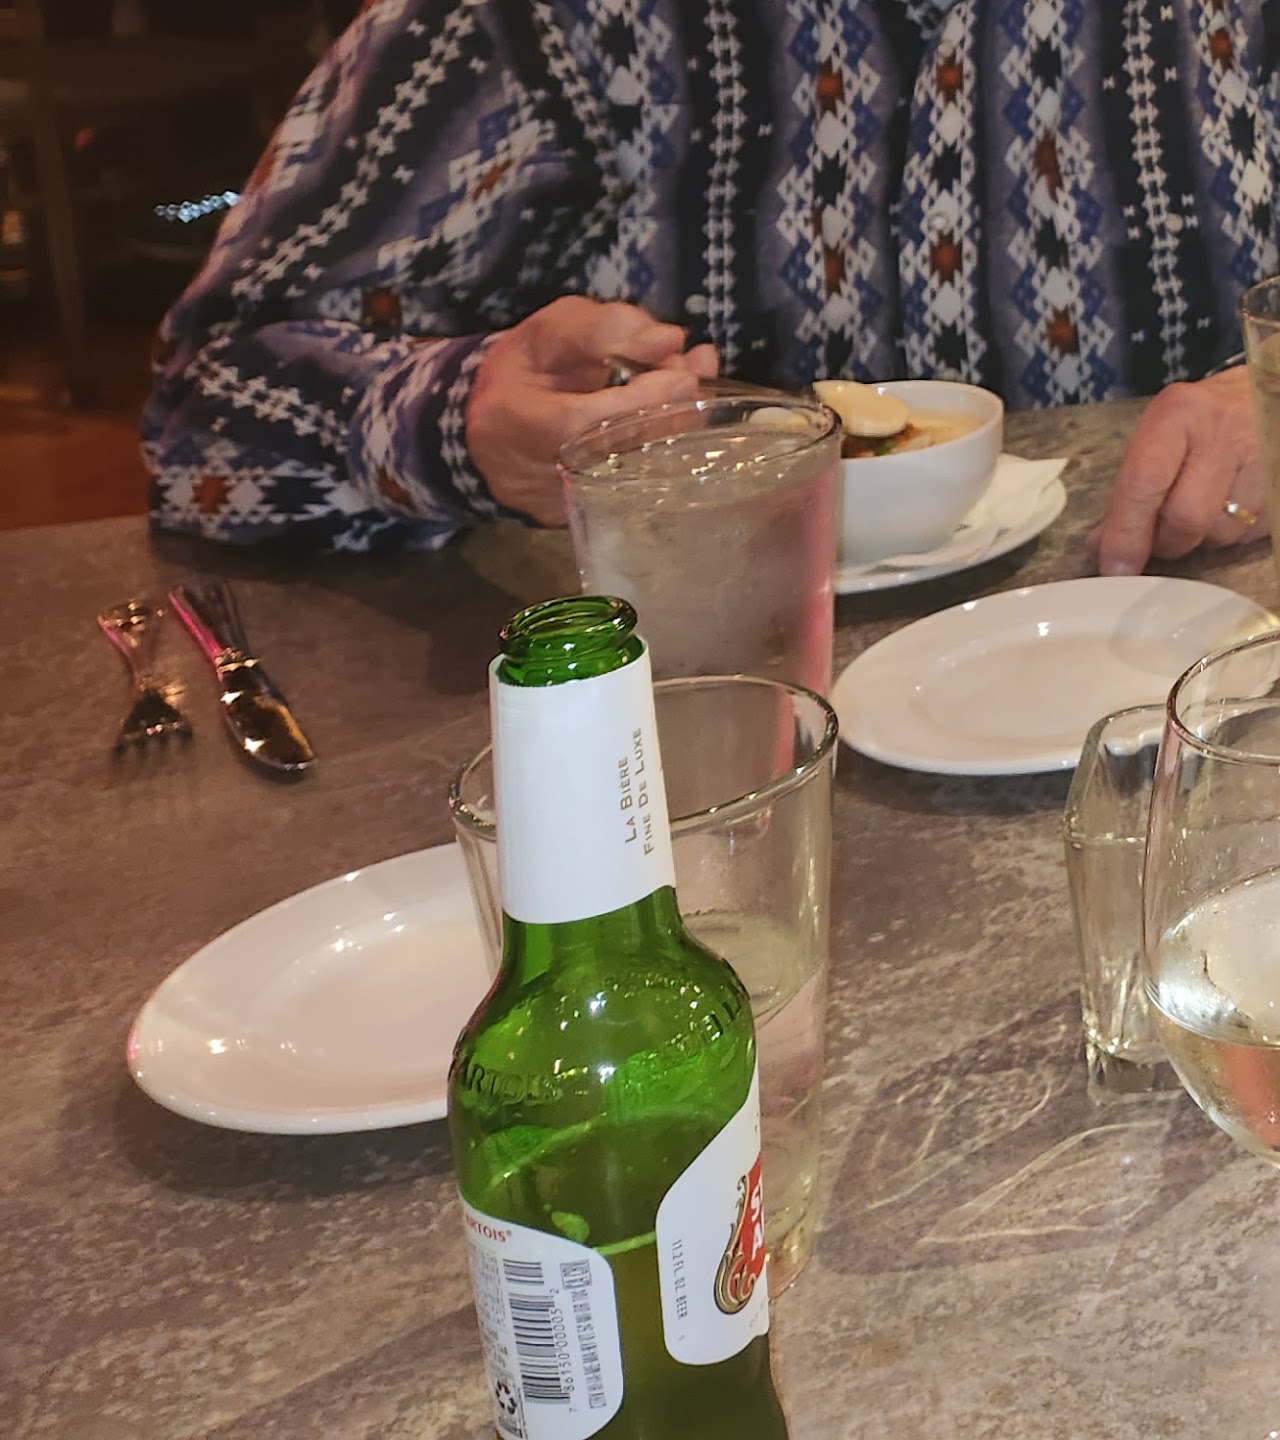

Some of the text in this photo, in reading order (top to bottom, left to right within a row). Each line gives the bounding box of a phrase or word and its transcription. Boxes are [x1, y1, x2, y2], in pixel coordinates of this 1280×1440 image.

[632, 727, 654, 857] FINE DE LUXE
[625, 816, 637, 844] LA
[676, 1295, 688, 1320] BEER
[550, 1307, 569, 1351] 00005
[558, 1353, 576, 1393] 86150
